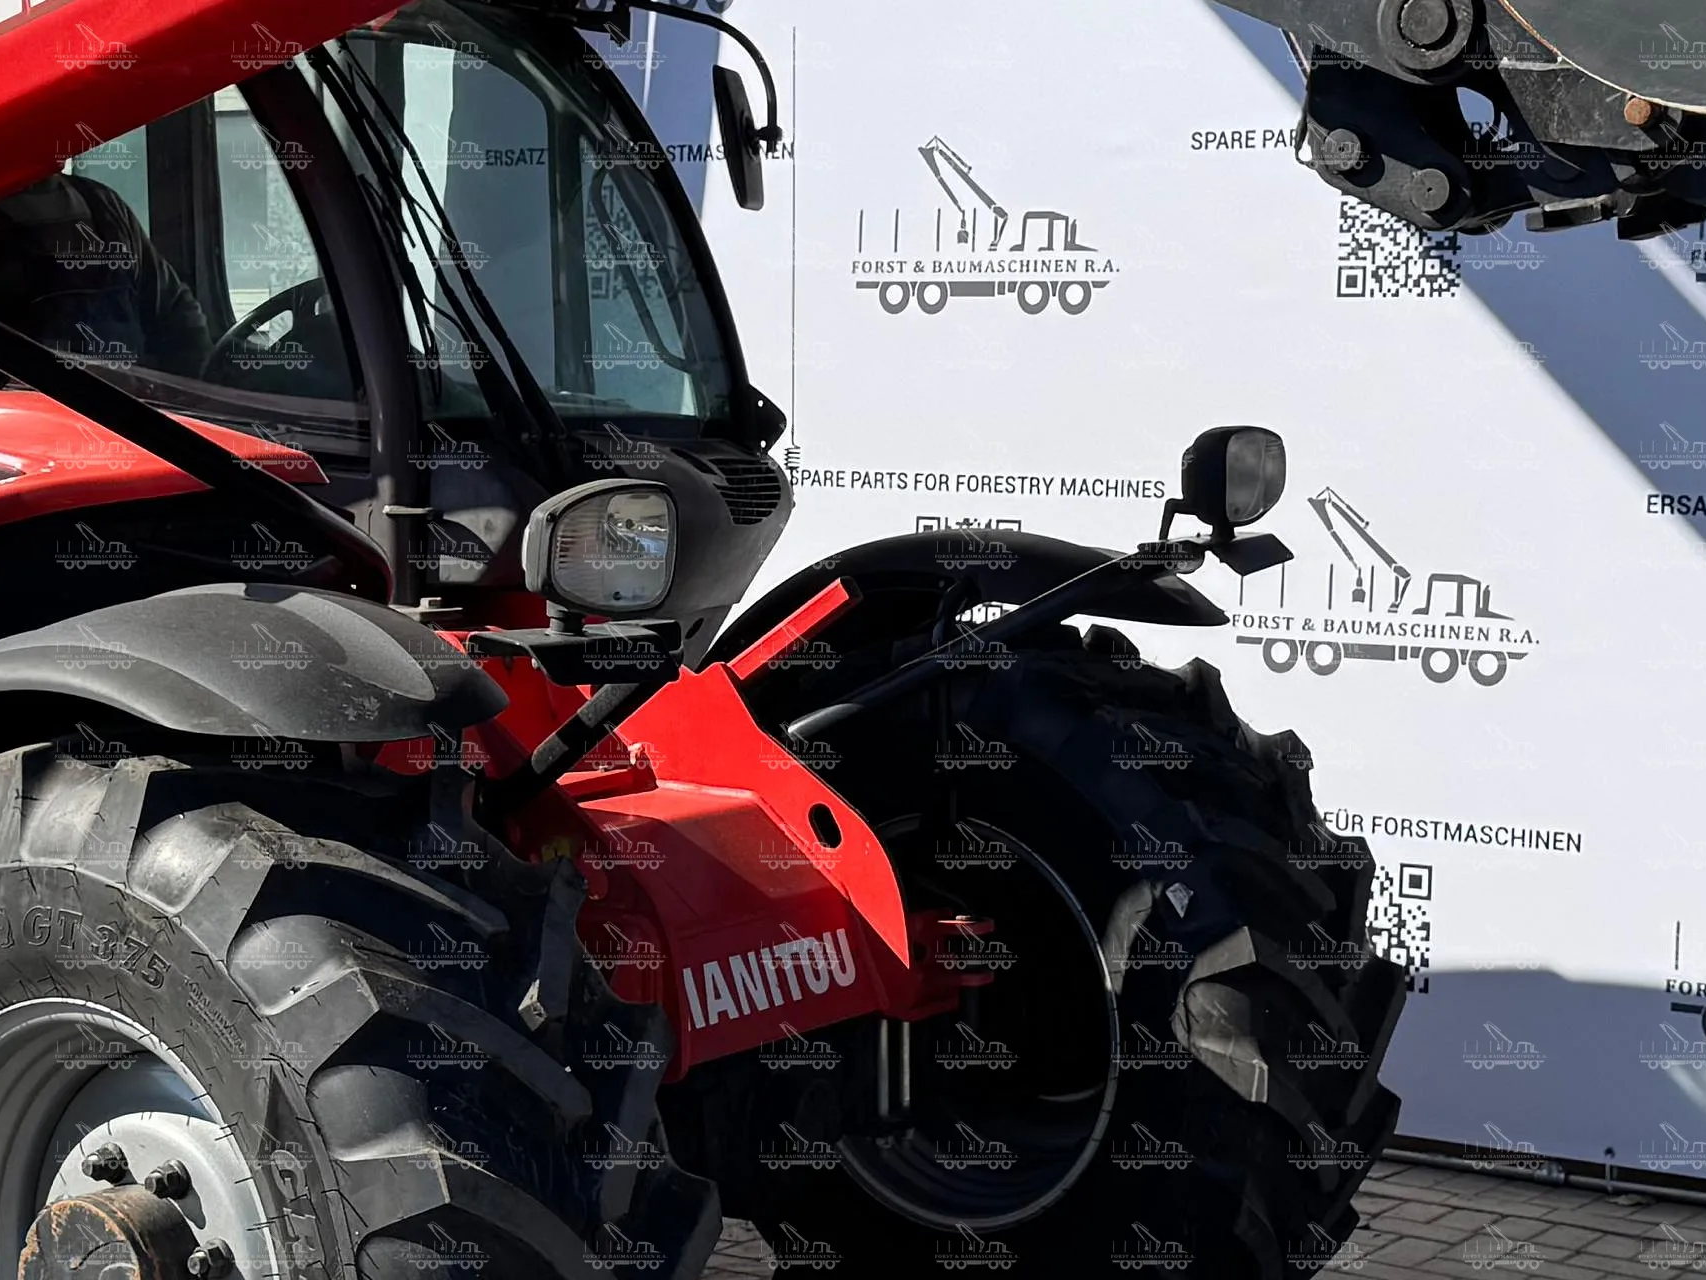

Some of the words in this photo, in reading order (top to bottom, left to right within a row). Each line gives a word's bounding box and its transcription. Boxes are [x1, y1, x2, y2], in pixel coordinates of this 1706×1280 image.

[1190, 129, 1256, 150] SPARE
[852, 260, 907, 274] FORST
[913, 260, 925, 274] &
[932, 259, 1078, 274] BAUMASCHINEN
[1084, 259, 1121, 273] R.A.
[790, 468, 846, 488] SPARE
[851, 471, 908, 490] PARTS
[913, 472, 950, 492] FOR
[955, 474, 1055, 496] FORESTRY
[1060, 477, 1166, 499] MACHINES
[1231, 614, 1295, 631] FORST
[1301, 617, 1317, 631] &
[1323, 618, 1491, 642] BAUMASCHINEN
[1498, 628, 1541, 645] R.A.
[1371, 815, 1582, 853] FORSTMASCHINEN
